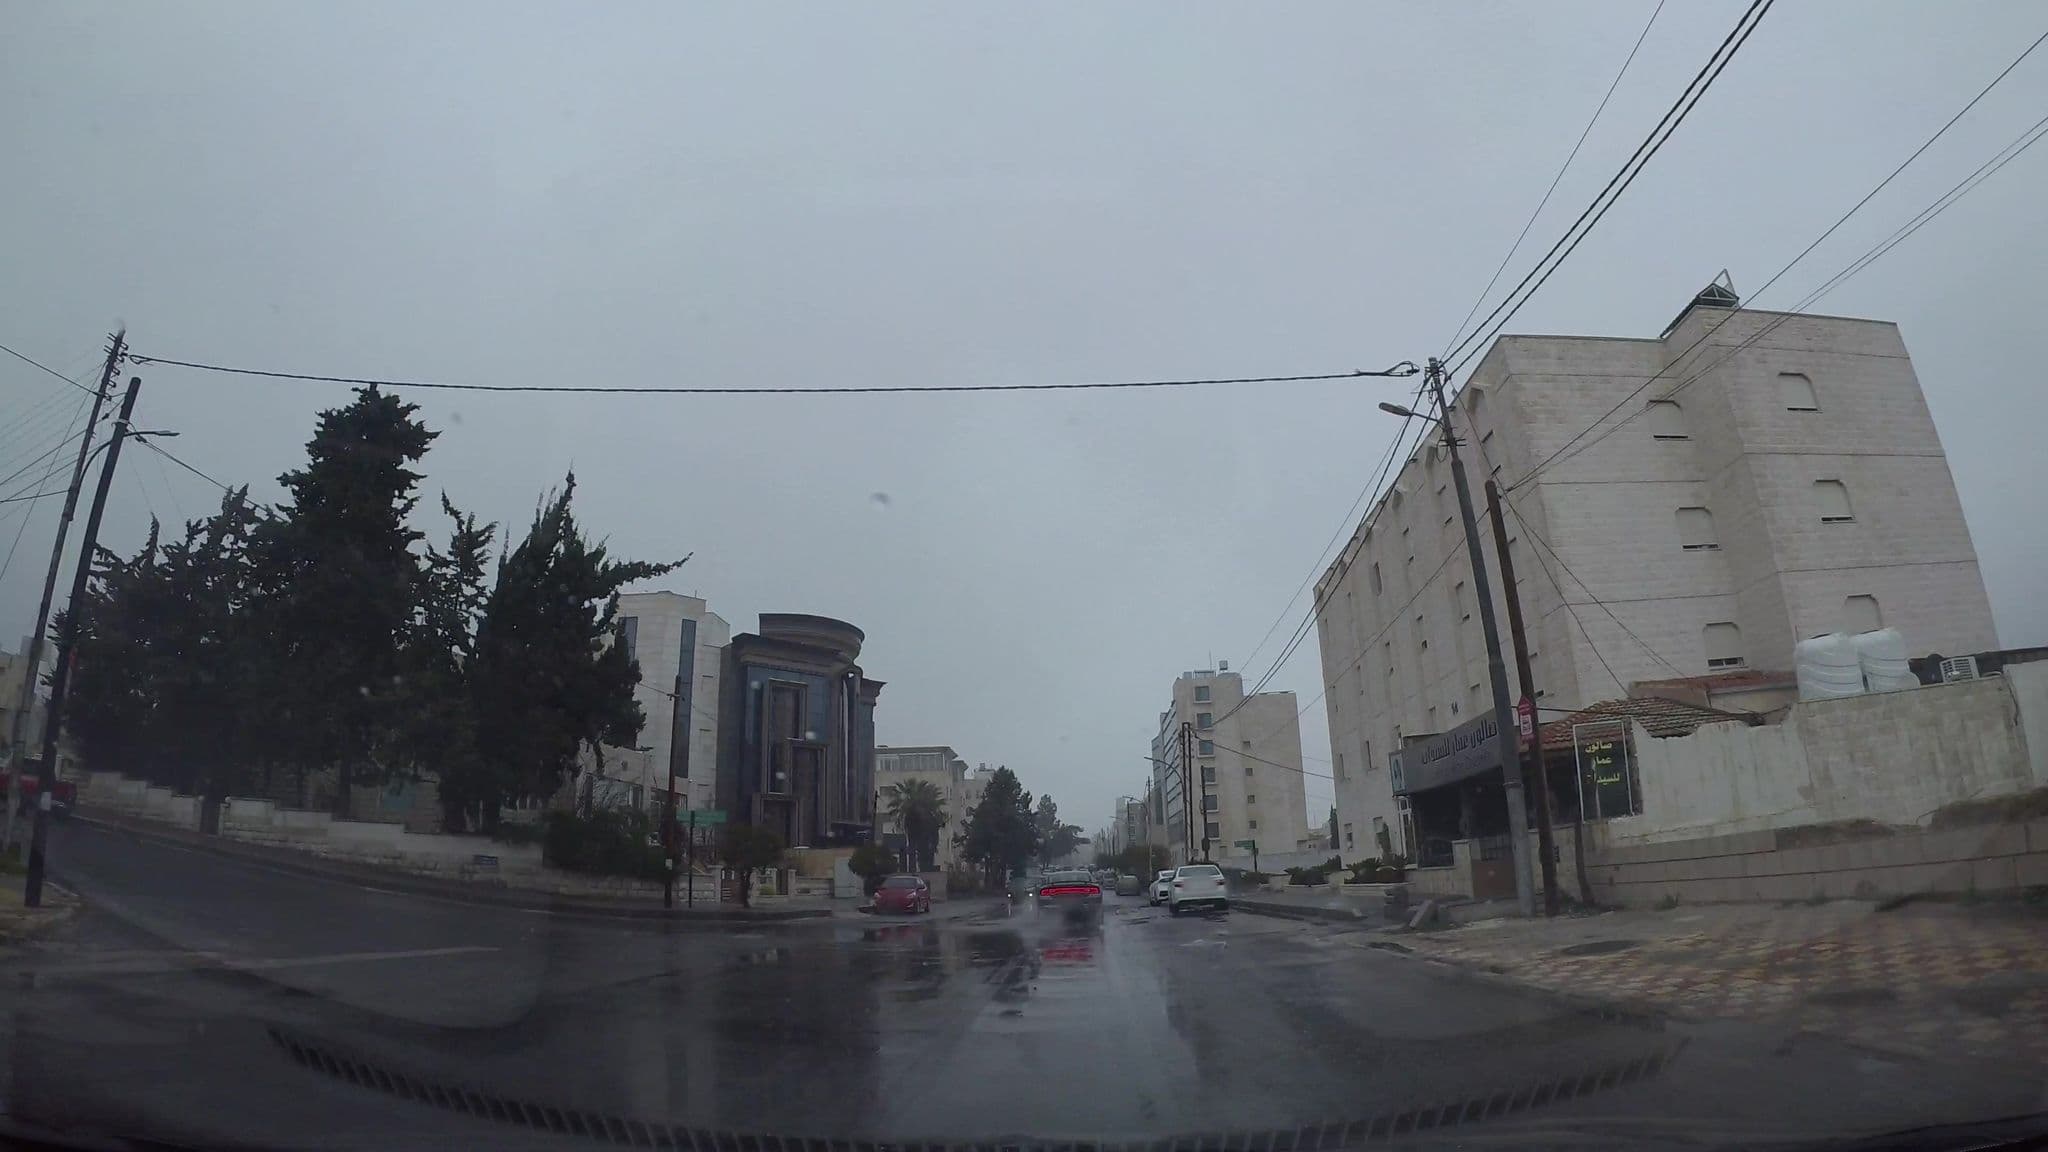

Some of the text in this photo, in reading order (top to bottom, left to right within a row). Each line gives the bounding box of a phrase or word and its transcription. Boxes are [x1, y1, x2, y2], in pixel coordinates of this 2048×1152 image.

[1471, 719, 1497, 748] صالون
[1583, 740, 1612, 753] صالون
[1591, 756, 1612, 768] عمار
